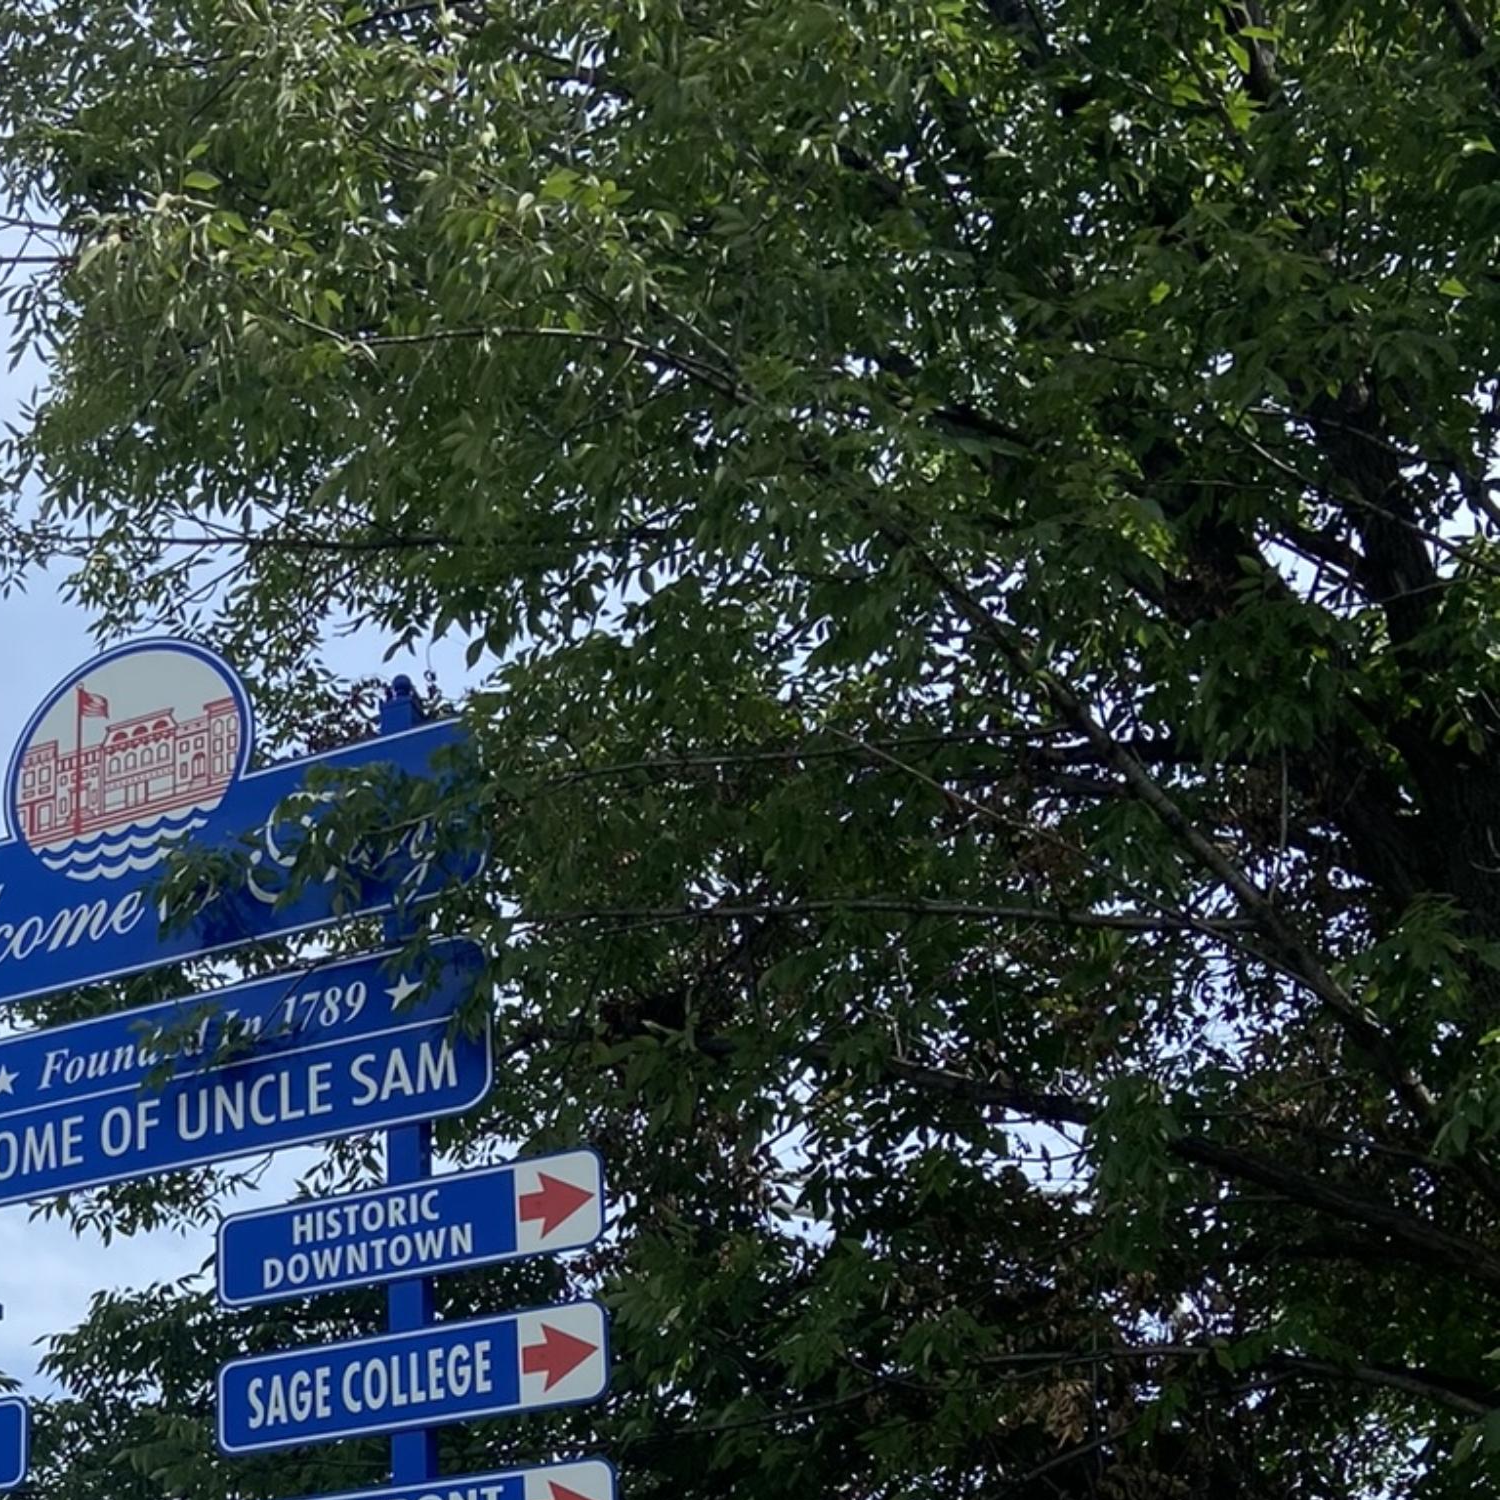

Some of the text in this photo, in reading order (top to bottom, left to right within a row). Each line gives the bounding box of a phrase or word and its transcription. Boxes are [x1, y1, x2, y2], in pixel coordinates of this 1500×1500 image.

[278, 980, 367, 1035] 1789
[101, 1099, 160, 1157] OF
[177, 1060, 332, 1143] UNCLE
[352, 1039, 458, 1107] SAM
[293, 1190, 439, 1245] HISTORIC
[263, 1223, 473, 1289] DOWNTOWN
[248, 1340, 492, 1429] SAGE COLLEGE
